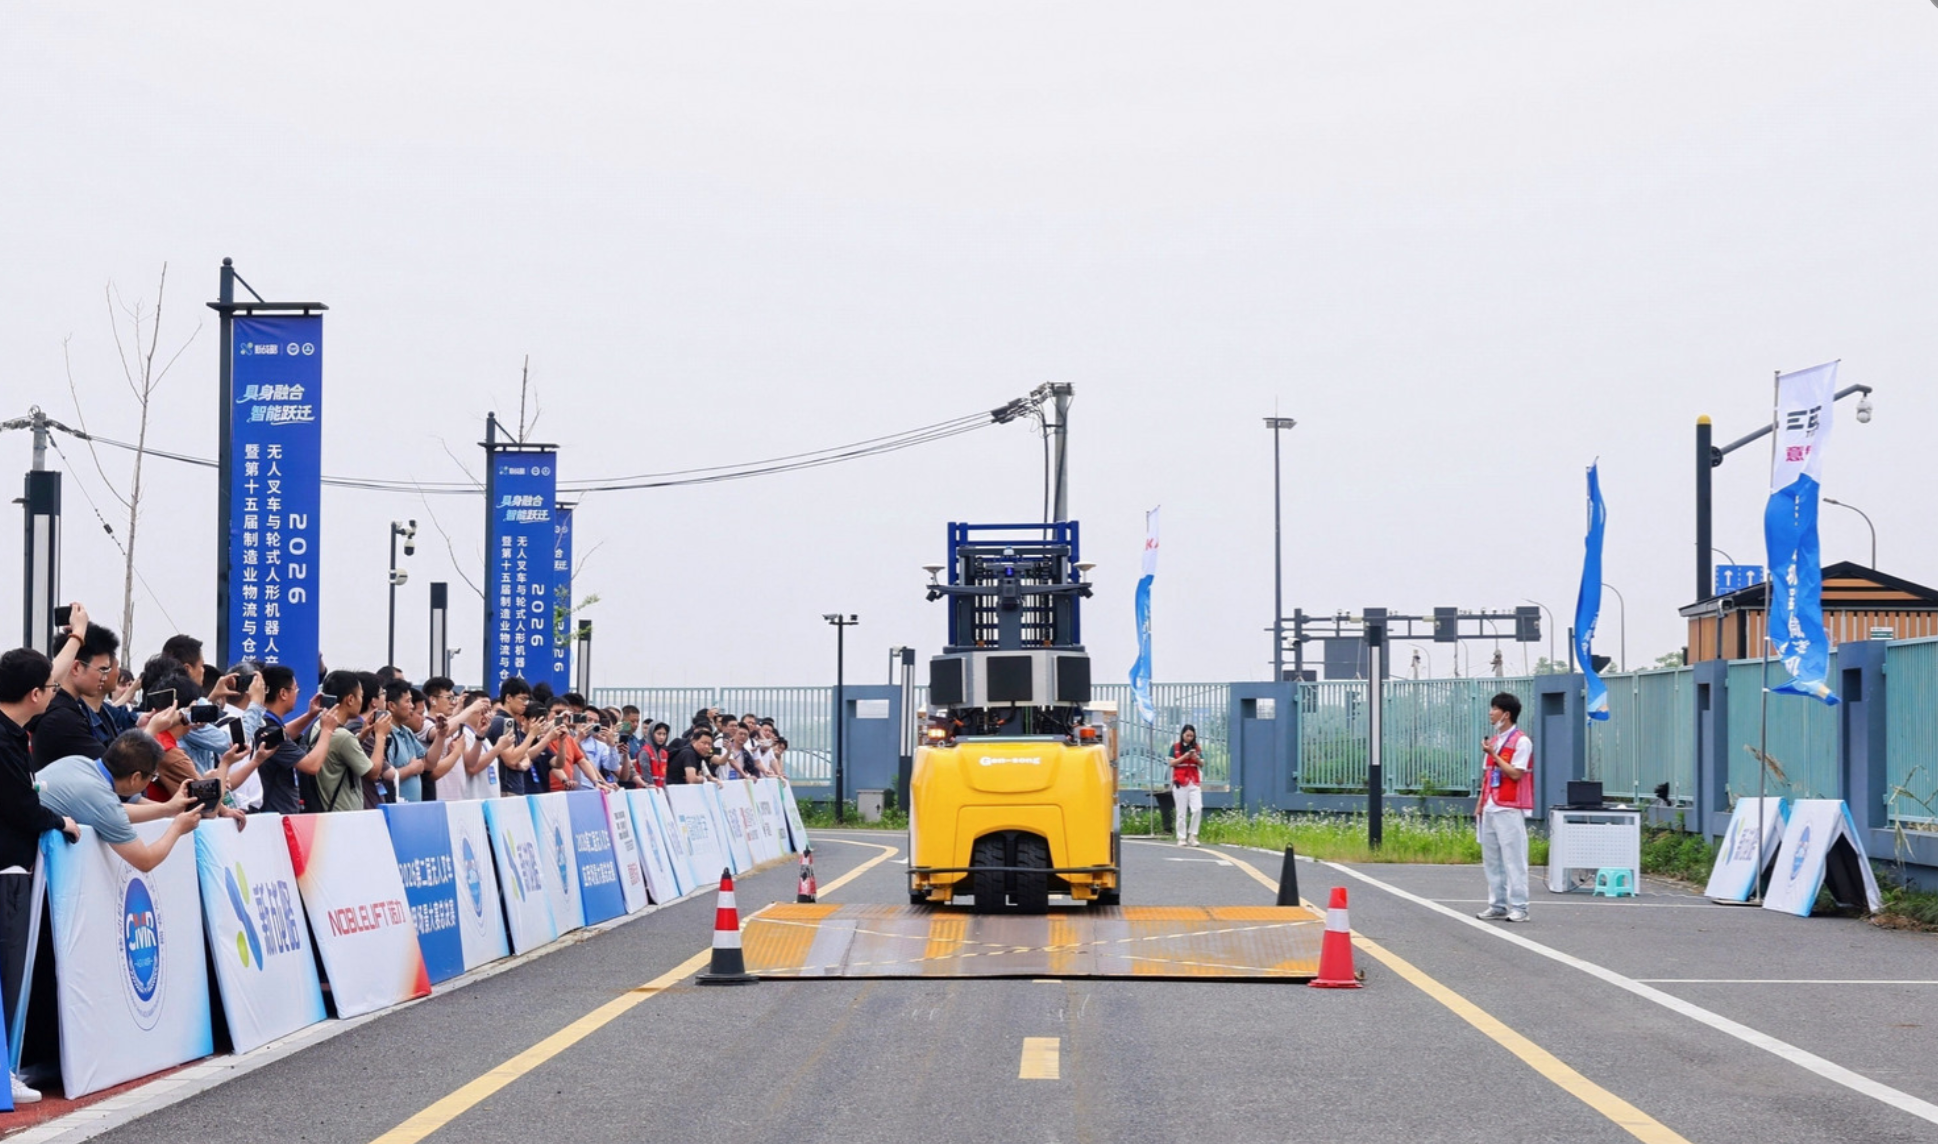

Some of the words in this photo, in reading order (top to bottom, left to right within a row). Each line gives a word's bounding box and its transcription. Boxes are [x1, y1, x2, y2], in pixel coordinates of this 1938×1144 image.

[238, 384, 305, 402] 具身融合
[249, 404, 315, 423] 智能跃迁
[288, 513, 307, 604] 2026
[530, 584, 545, 647] 2026
[328, 901, 389, 937] NOBLELIFT
